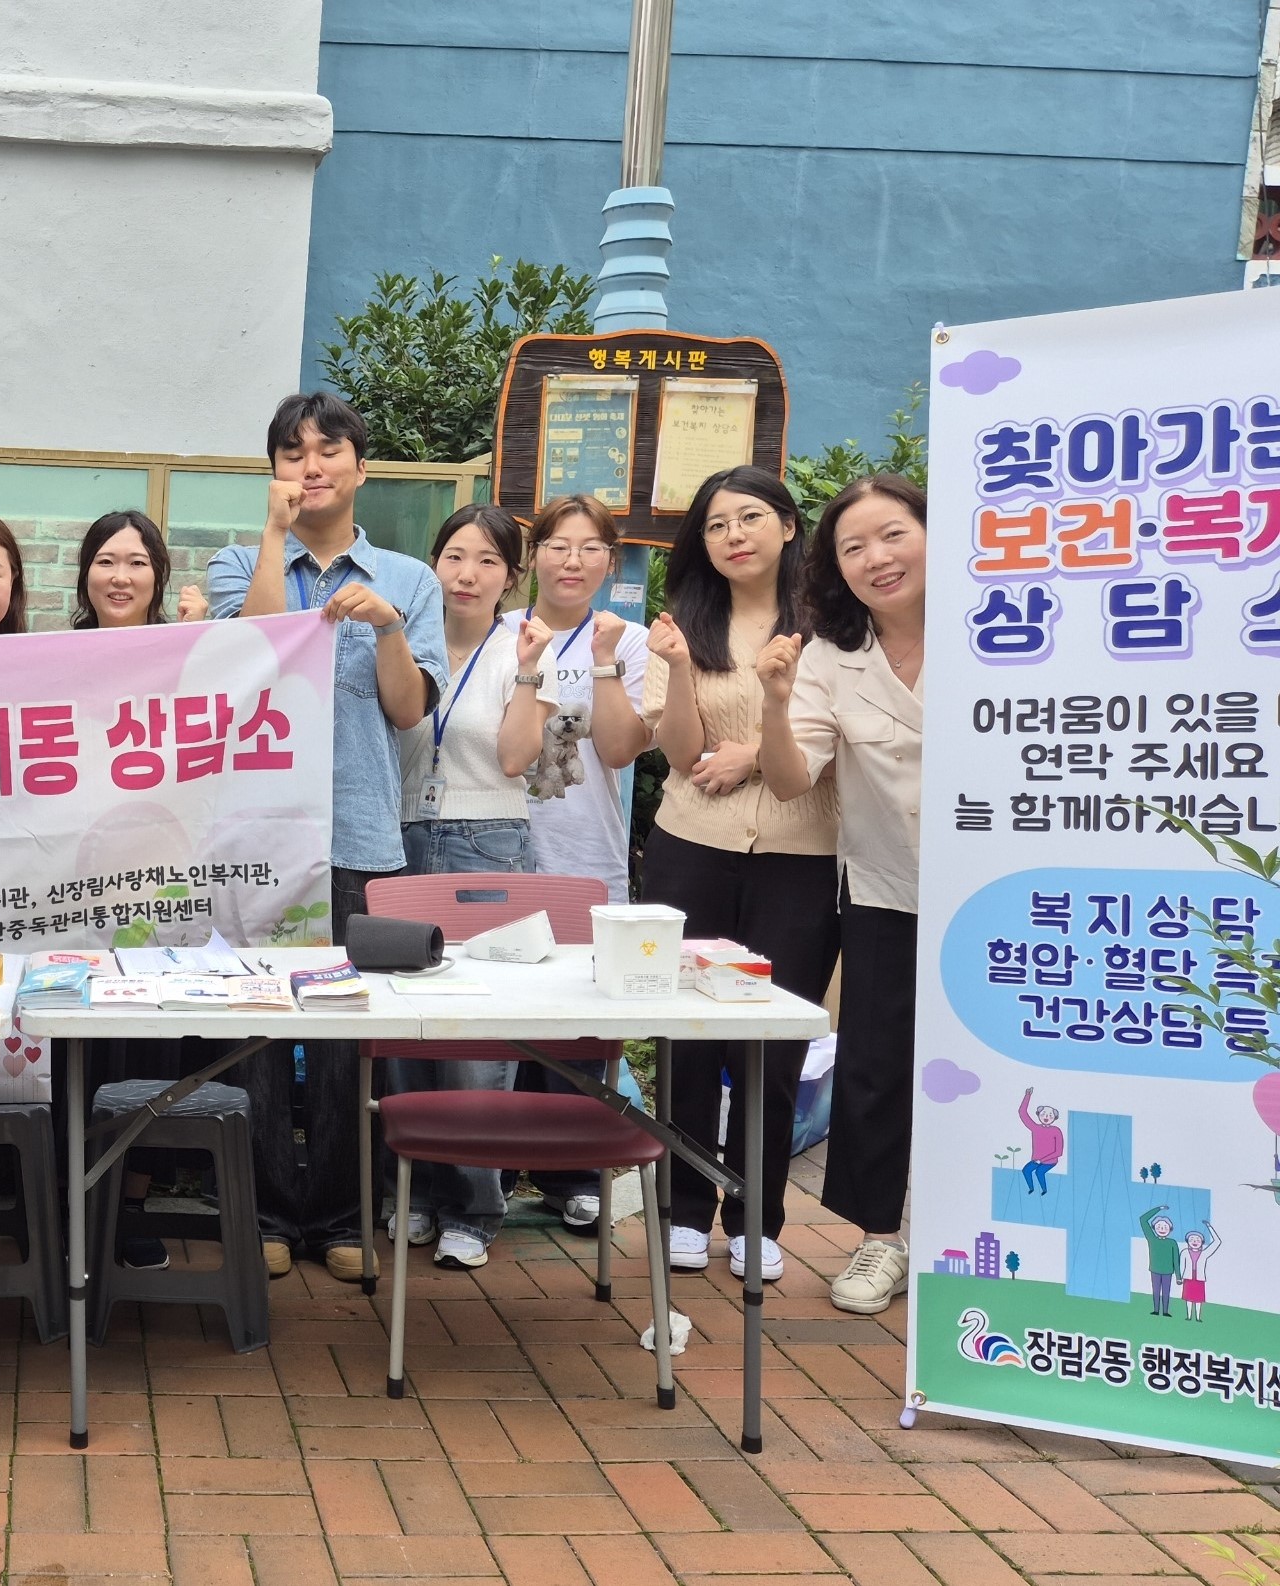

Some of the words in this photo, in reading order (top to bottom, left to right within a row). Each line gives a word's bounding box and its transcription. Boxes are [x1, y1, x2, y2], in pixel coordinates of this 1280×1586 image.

[589, 349, 708, 371] 행복게시판
[691, 404, 726, 418] 찾아가는
[973, 695, 1148, 736] 어려움이
[1166, 691, 1260, 733] 있을
[105, 687, 294, 790] 상담소
[1021, 743, 1114, 782] 연락
[1128, 741, 1269, 781] 주세요
[955, 793, 995, 833] 늘
[46, 862, 279, 905] 신장림사랑채노인복지관,
[987, 938, 1198, 994] 혈압·혈당
[1213, 952, 1280, 996] 측
[1018, 994, 1203, 1049] 건강상담
[1224, 1006, 1270, 1053] 등
[1026, 1329, 1131, 1385] 장림2동
